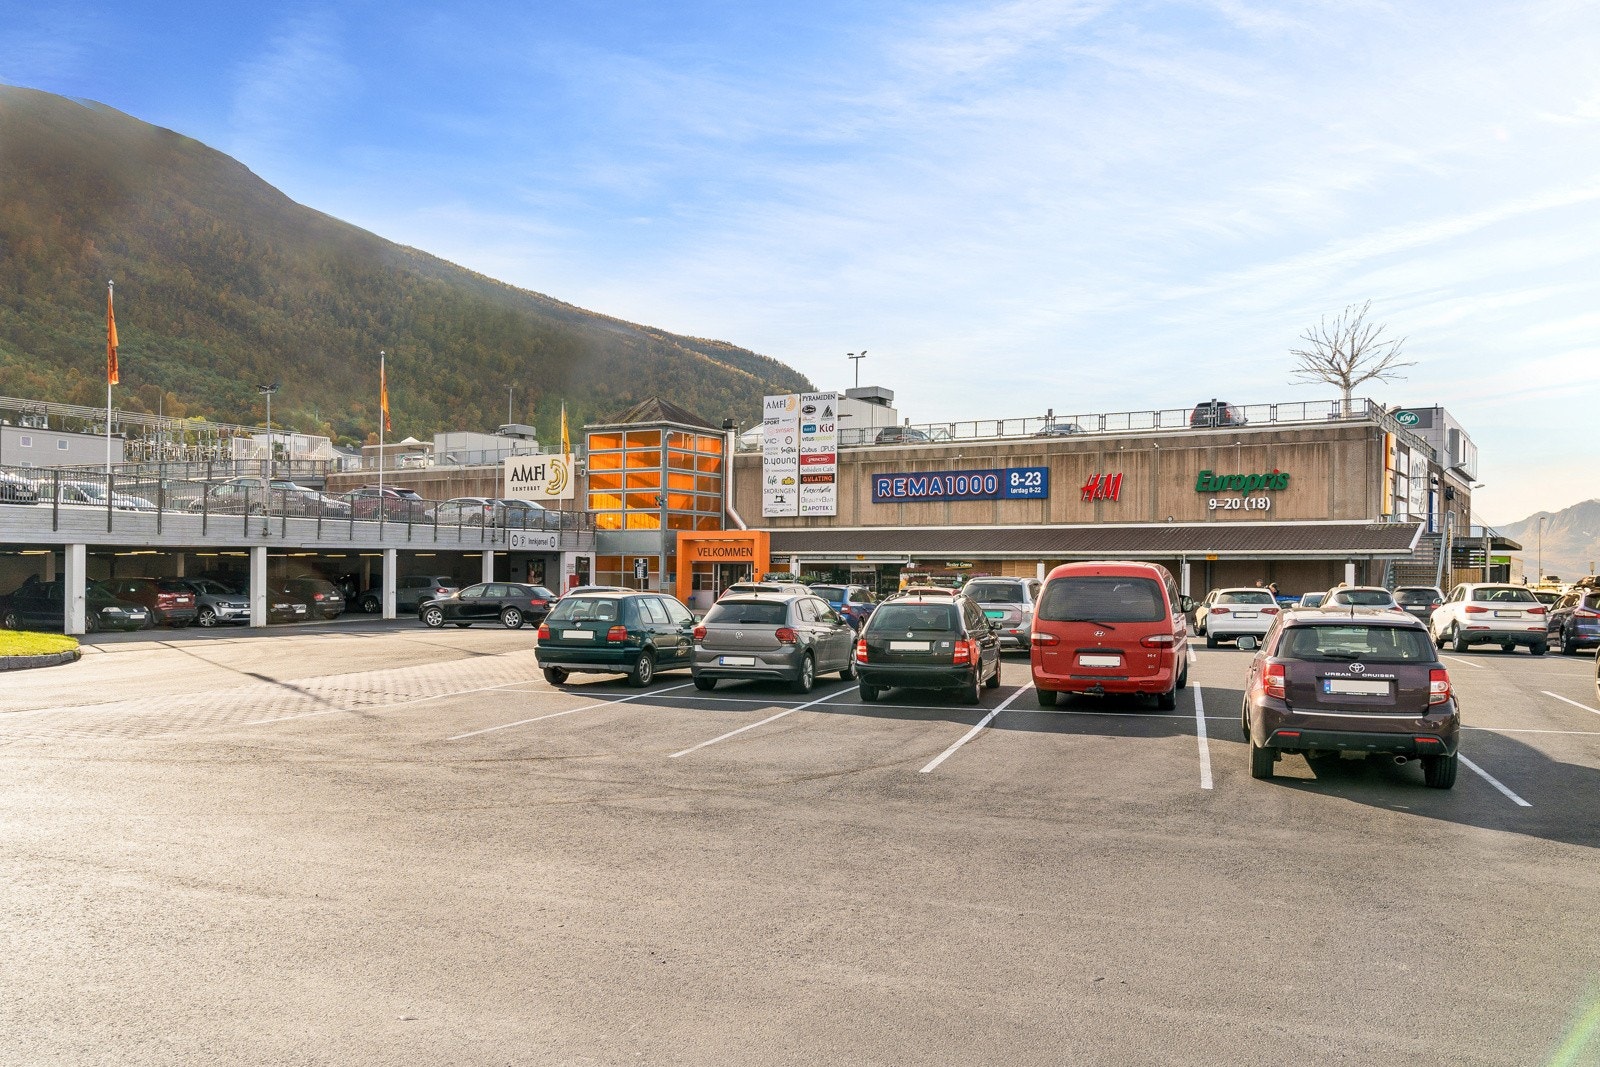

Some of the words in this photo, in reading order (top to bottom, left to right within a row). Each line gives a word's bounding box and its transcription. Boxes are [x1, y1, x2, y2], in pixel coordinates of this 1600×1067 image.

[802, 393, 836, 402] PYRAMIDEN
[766, 399, 787, 409] AMFI
[819, 423, 834, 433] Kid
[764, 457, 797, 466] b.young
[510, 464, 546, 483] AMFI
[802, 475, 833, 483] GULATING
[1010, 472, 1042, 486] 8-23
[1195, 468, 1290, 497] Europris
[1081, 472, 1124, 503] H&M
[1209, 498, 1241, 510] 9-20
[1244, 496, 1271, 511] (18)
[697, 547, 753, 557] VELKOMMEN
